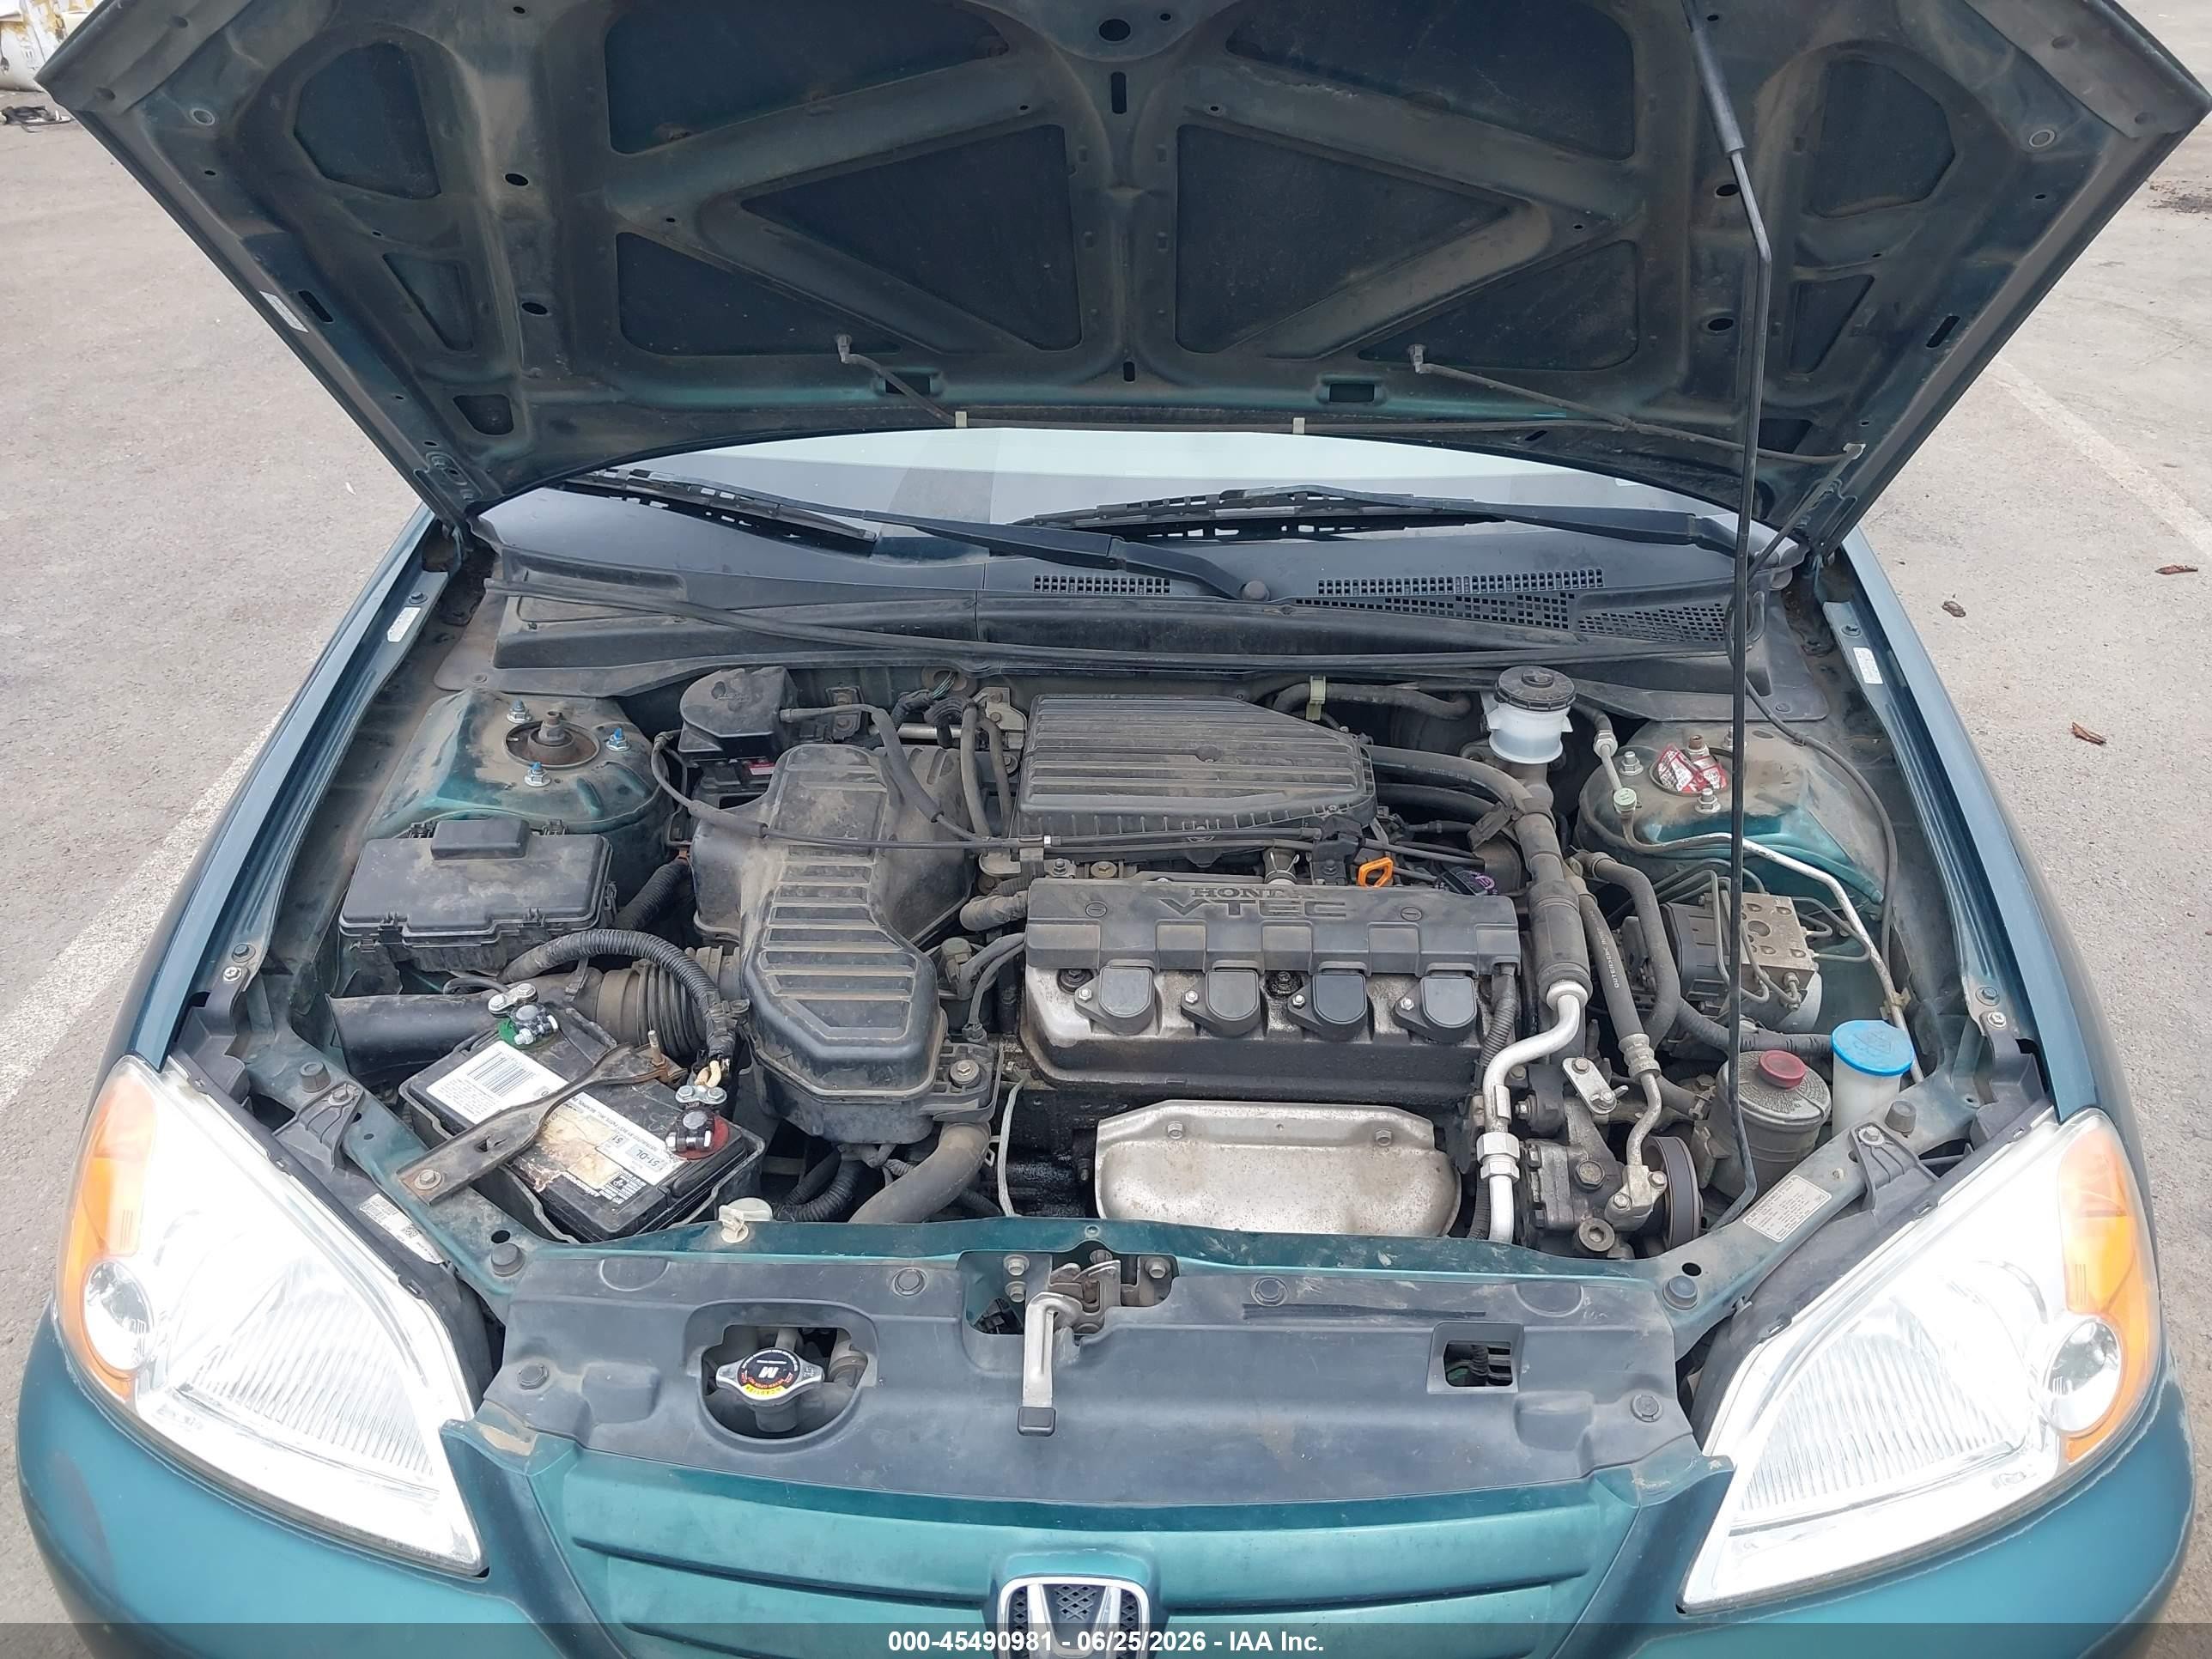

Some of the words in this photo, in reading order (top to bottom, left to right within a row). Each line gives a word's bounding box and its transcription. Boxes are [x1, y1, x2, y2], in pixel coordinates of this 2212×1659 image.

[1160, 899, 1346, 917] VTEC
[611, 1135, 623, 1145] 51
[635, 1149, 660, 1167] 51-DL
